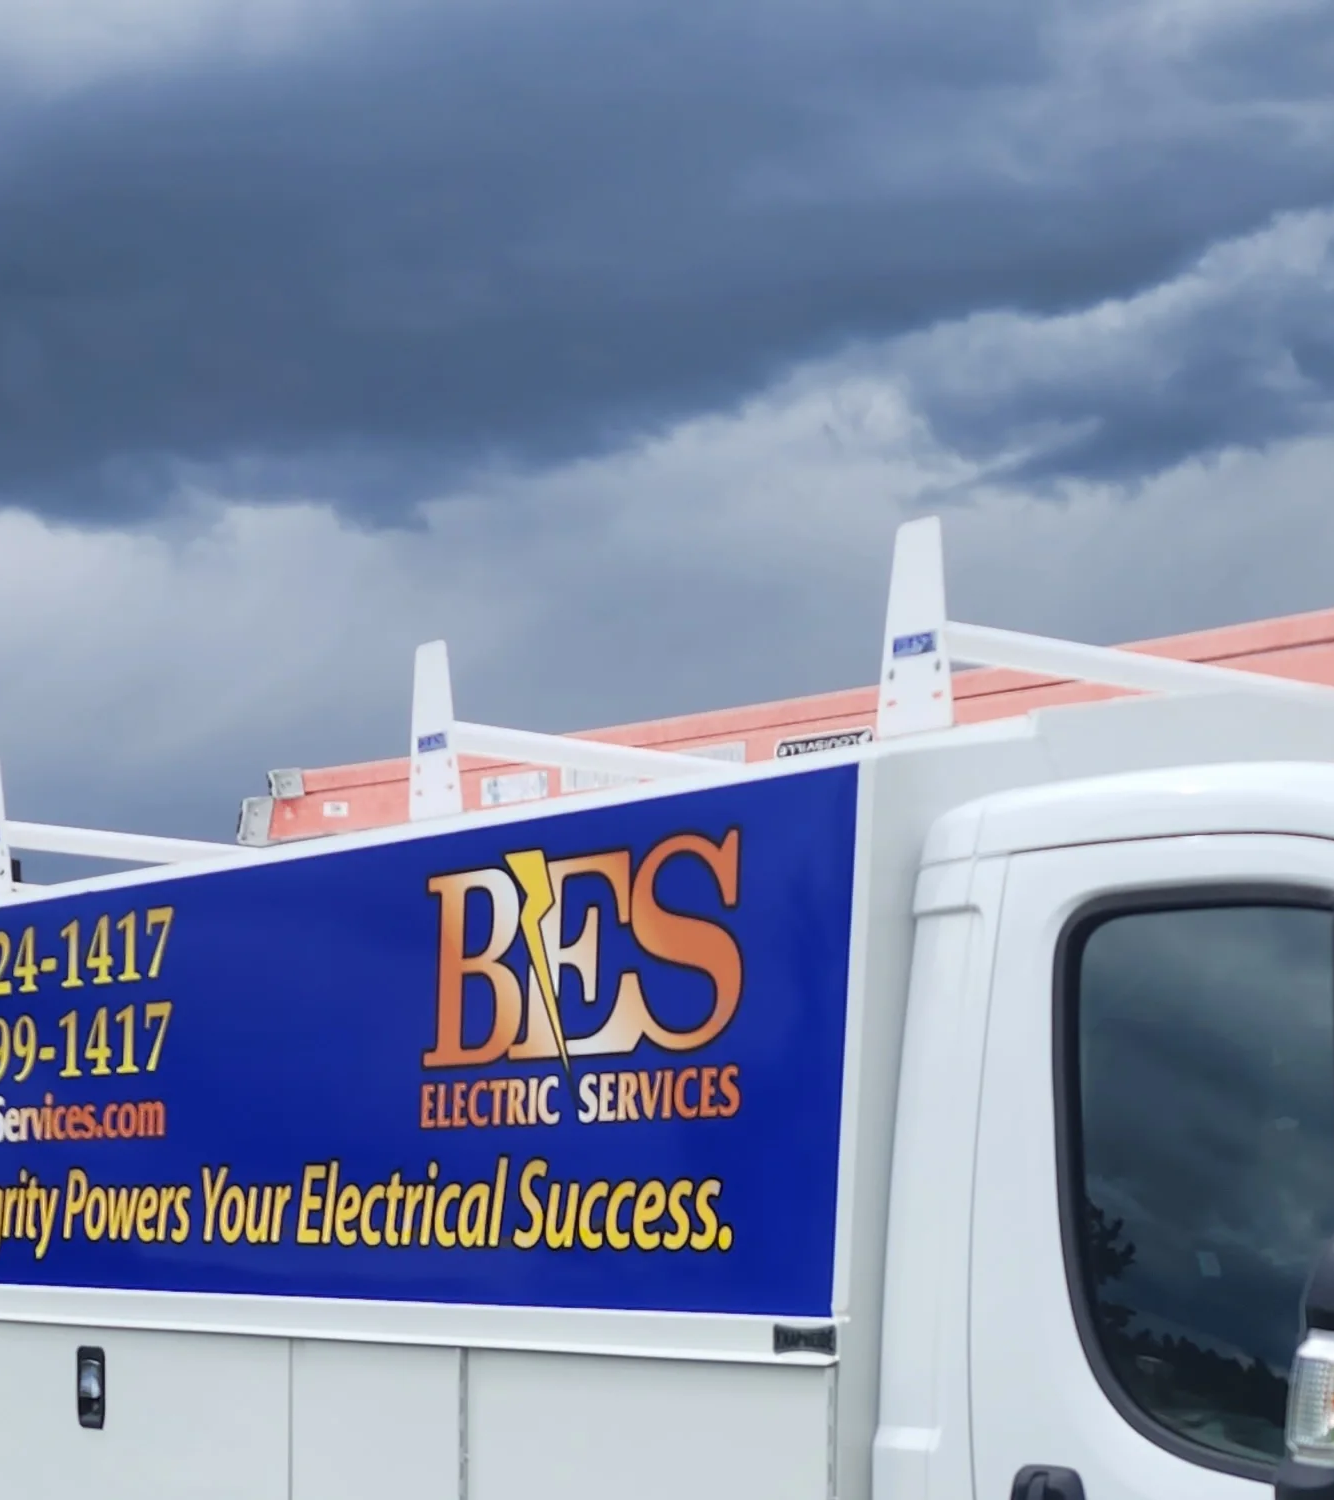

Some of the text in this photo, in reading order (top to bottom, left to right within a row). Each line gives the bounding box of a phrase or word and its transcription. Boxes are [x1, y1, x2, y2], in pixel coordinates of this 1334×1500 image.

[422, 826, 743, 1069] BES
[419, 1064, 741, 1130] ELECTRIC SERVICES
[62, 1167, 192, 1243] Powers
[201, 1166, 293, 1244] Your
[295, 1156, 510, 1247] Electrical
[512, 1157, 734, 1251] Success.
